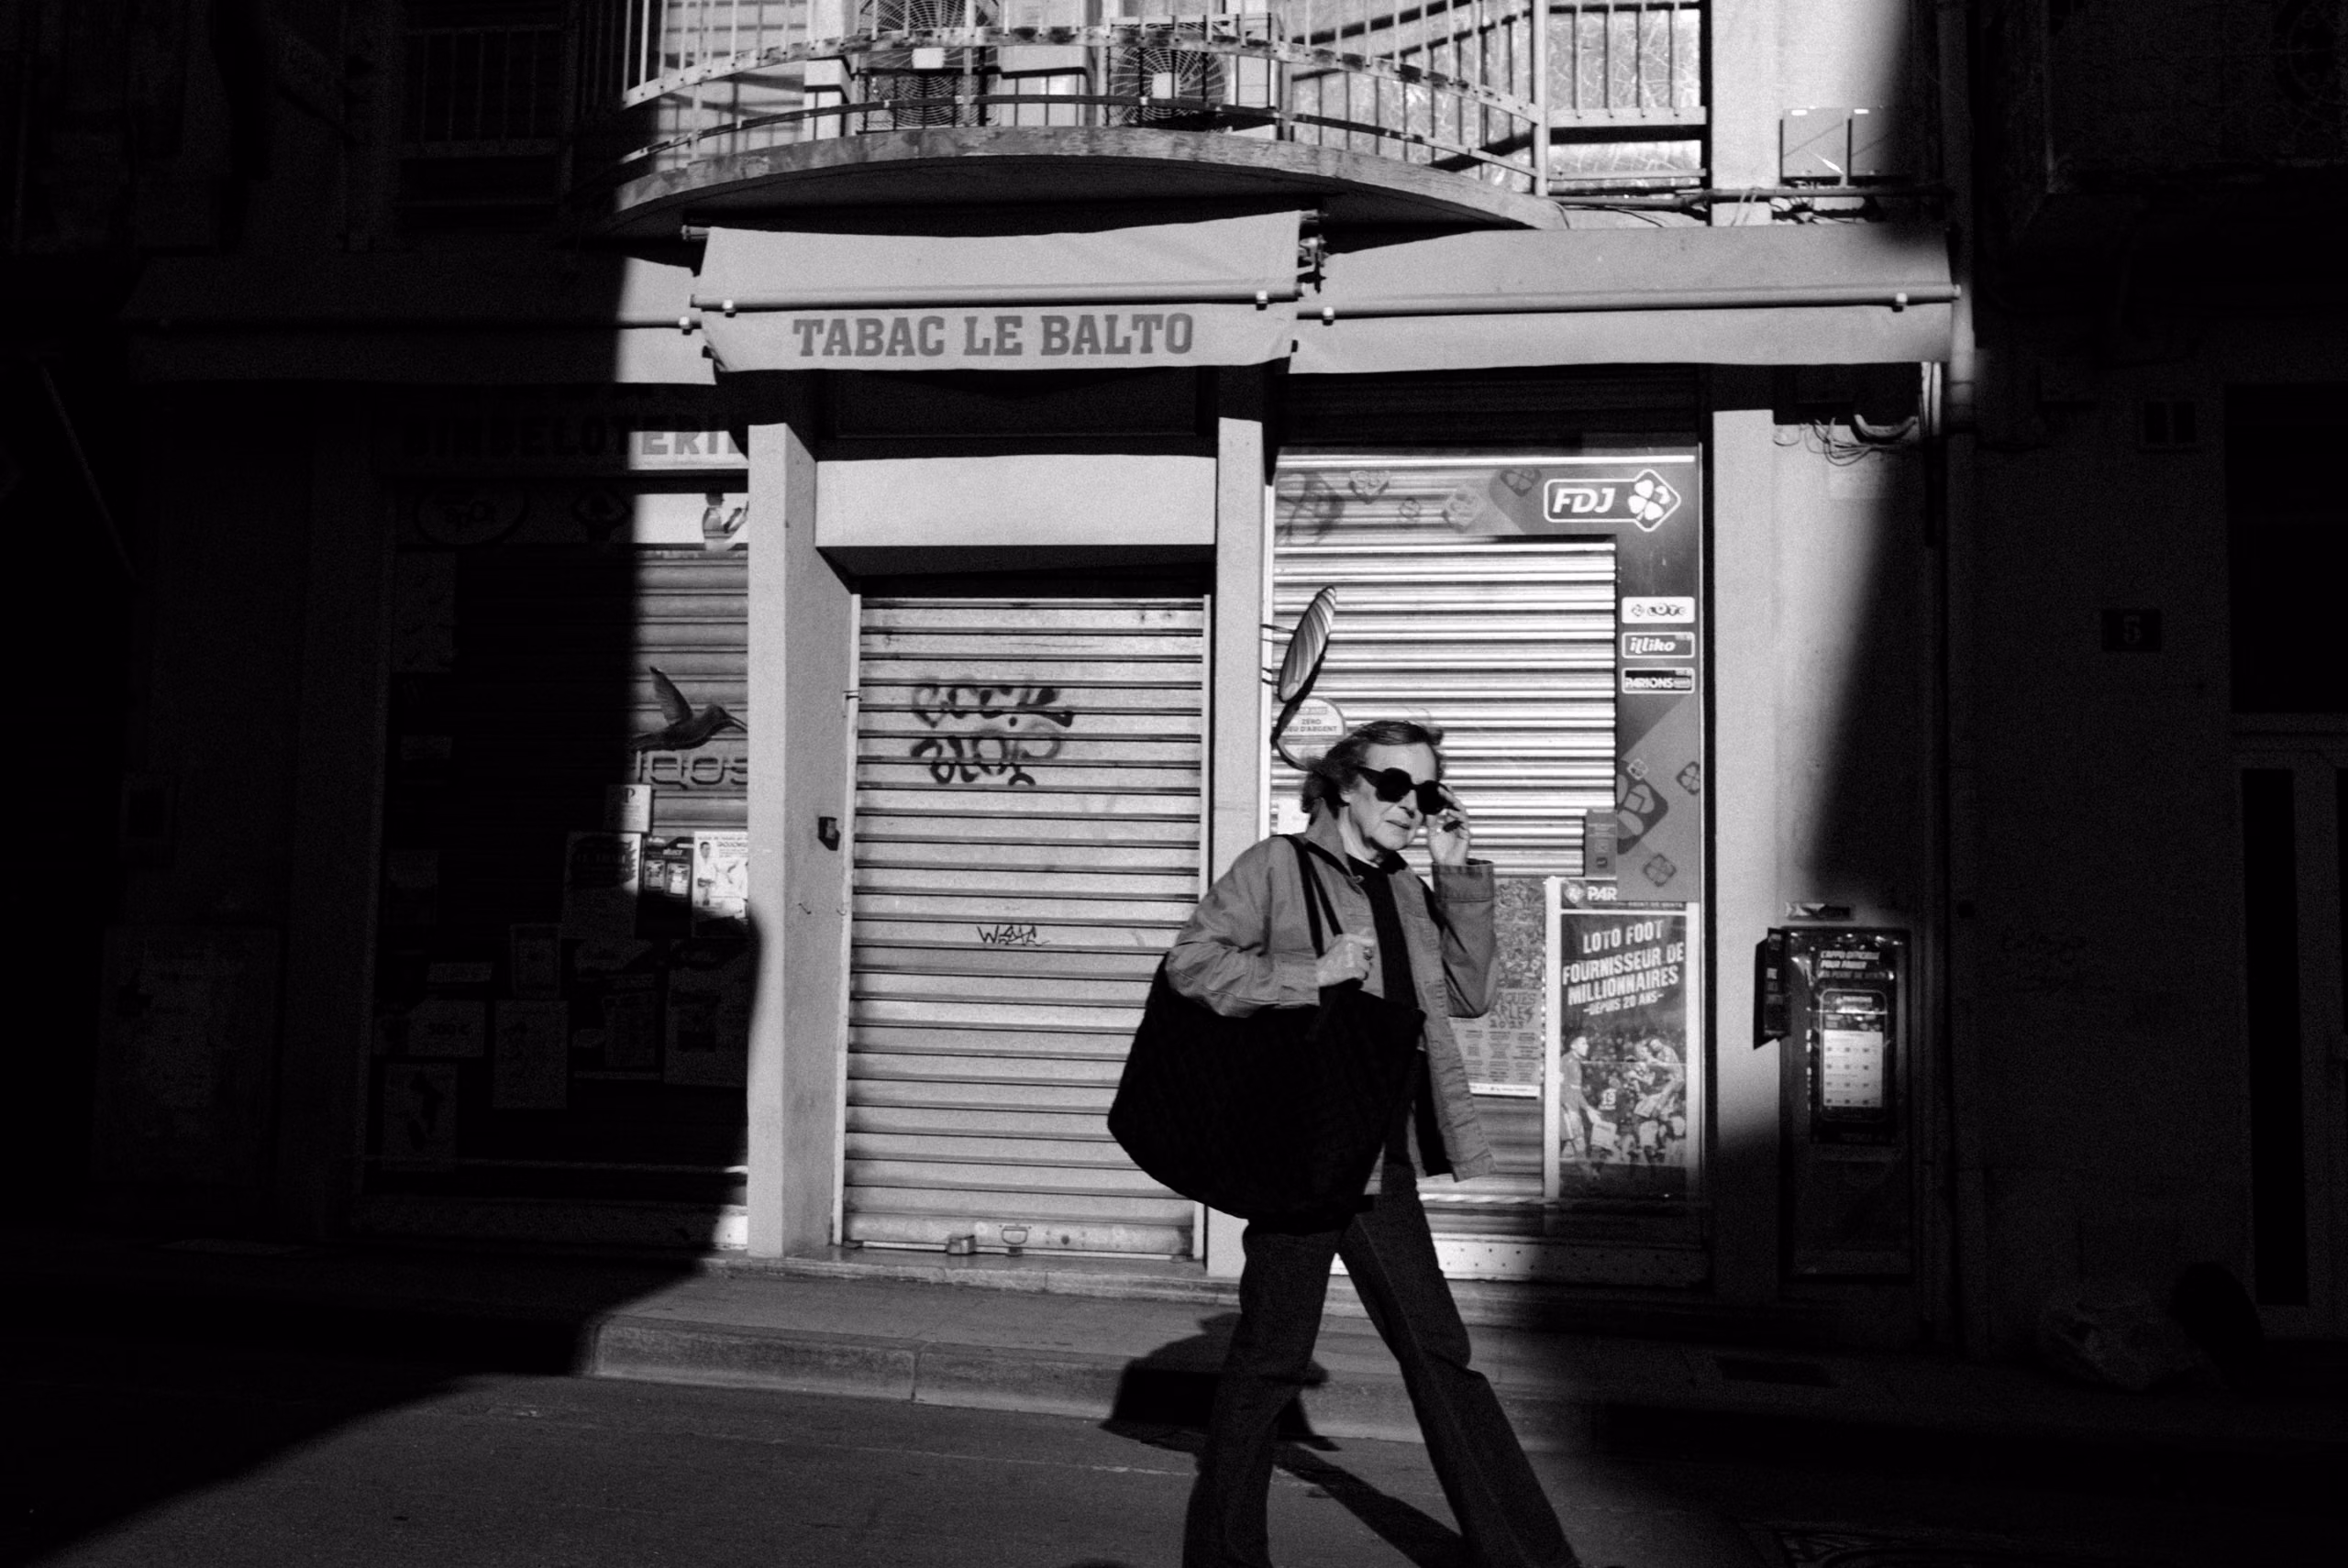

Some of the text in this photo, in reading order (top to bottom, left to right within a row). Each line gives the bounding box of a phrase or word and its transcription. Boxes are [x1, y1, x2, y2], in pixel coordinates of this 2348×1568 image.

[793, 313, 1194, 357] TABAC LE BALTO
[1553, 487, 1615, 513] FDJ
[2121, 615, 2143, 645] 5
[1630, 637, 1676, 655] illiko
[1625, 678, 1674, 690] PARIONS
[1583, 920, 1664, 954] LOTO FOOT
[1562, 942, 1685, 986] FOURNISSEUR DE
[1567, 965, 1679, 1006] MILLIONNAIRES
[1623, 995, 1636, 1010] 20
